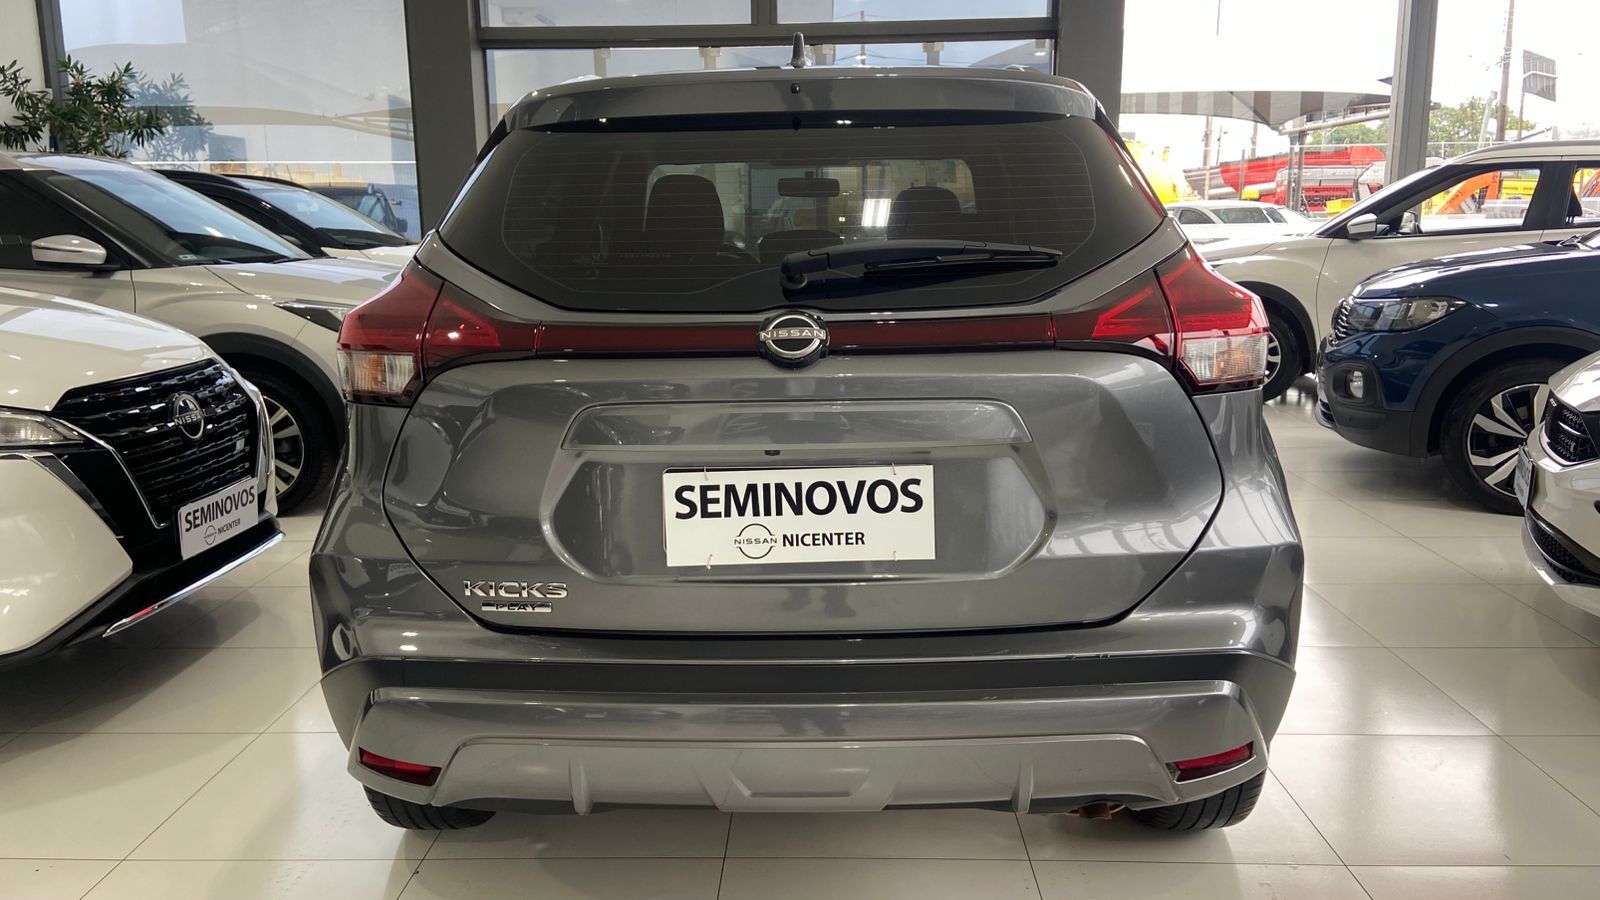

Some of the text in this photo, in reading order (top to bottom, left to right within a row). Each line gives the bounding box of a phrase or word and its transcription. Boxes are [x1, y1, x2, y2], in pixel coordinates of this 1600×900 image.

[761, 329, 824, 339] NISSAN
[674, 478, 924, 520] SEMINOVOS
[185, 486, 255, 532] SEMINOVOS
[217, 518, 241, 535] NICENTER
[733, 532, 866, 547] NISSAN NICENTER
[463, 580, 568, 598] KICKS
[495, 602, 537, 611] PLAY
